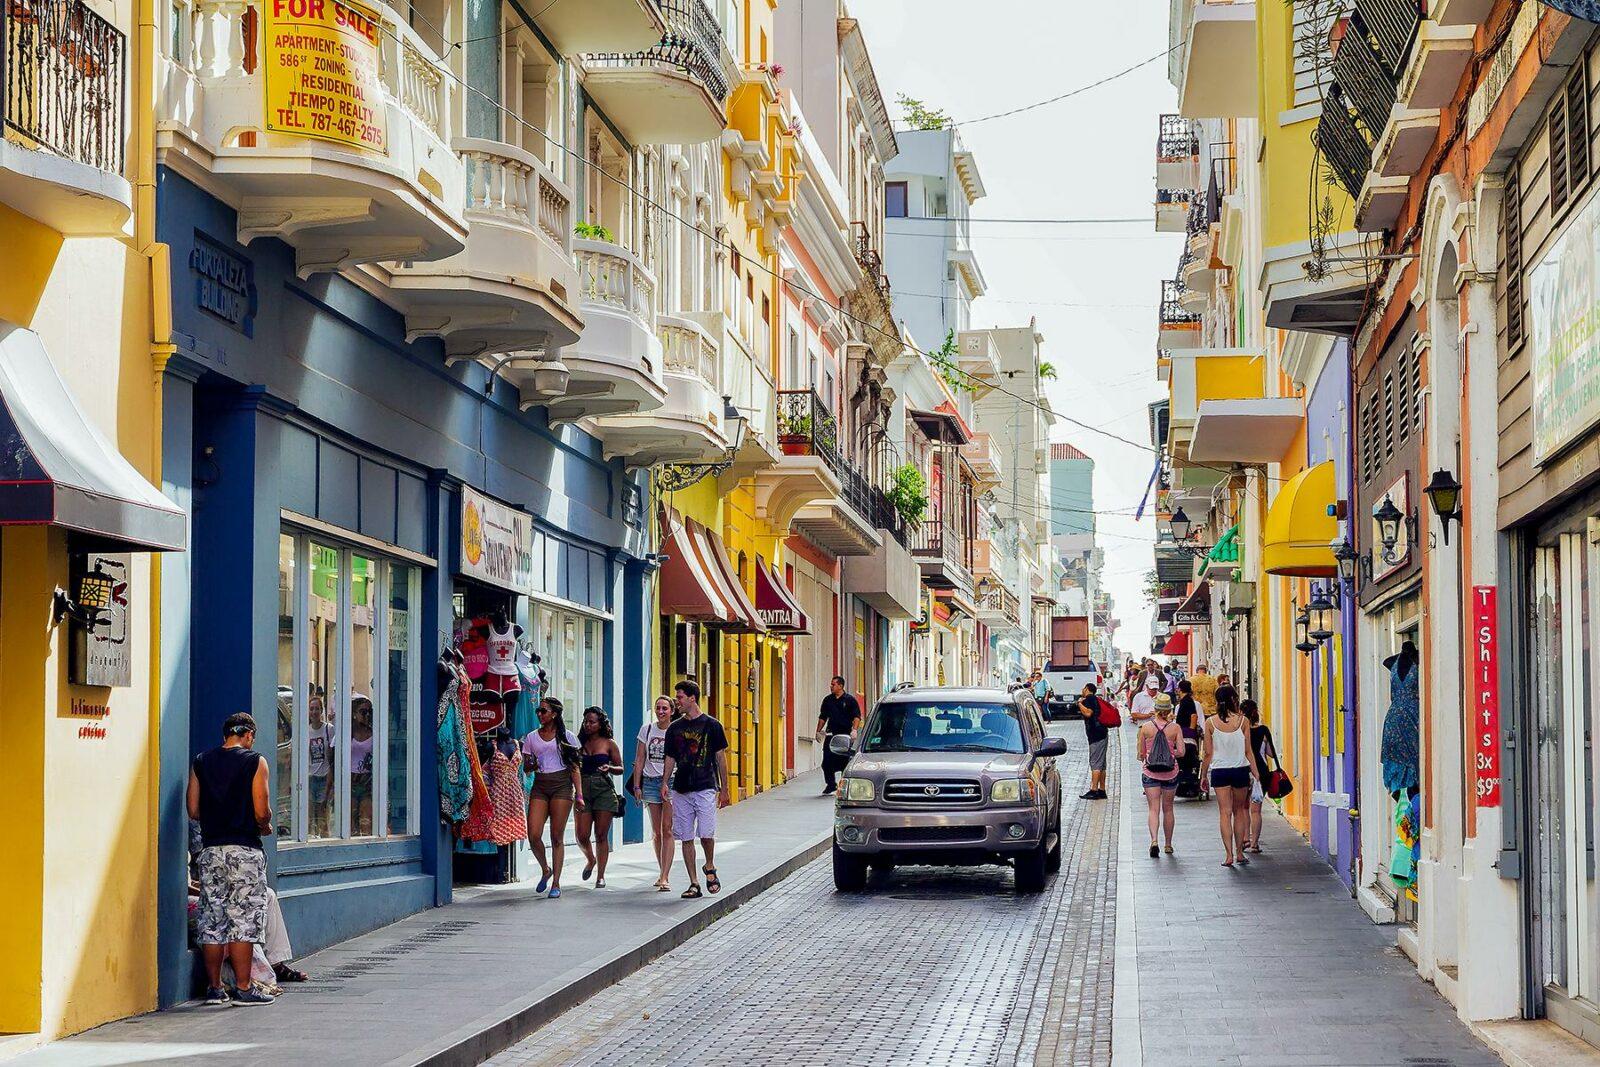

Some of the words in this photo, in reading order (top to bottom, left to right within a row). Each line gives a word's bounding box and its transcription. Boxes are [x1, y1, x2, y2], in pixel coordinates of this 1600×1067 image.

[273, 0, 325, 20] FOR
[335, 2, 376, 41] SALE
[280, 54, 299, 68] 586
[314, 57, 346, 76] ZONING
[301, 73, 366, 102] RESIDENTIAL
[289, 91, 336, 112] TIEMPO
[339, 103, 375, 124] REALTY
[277, 109, 306, 128] TEL.
[310, 112, 382, 145] 787-467-2675
[758, 608, 792, 624] TANTRA
